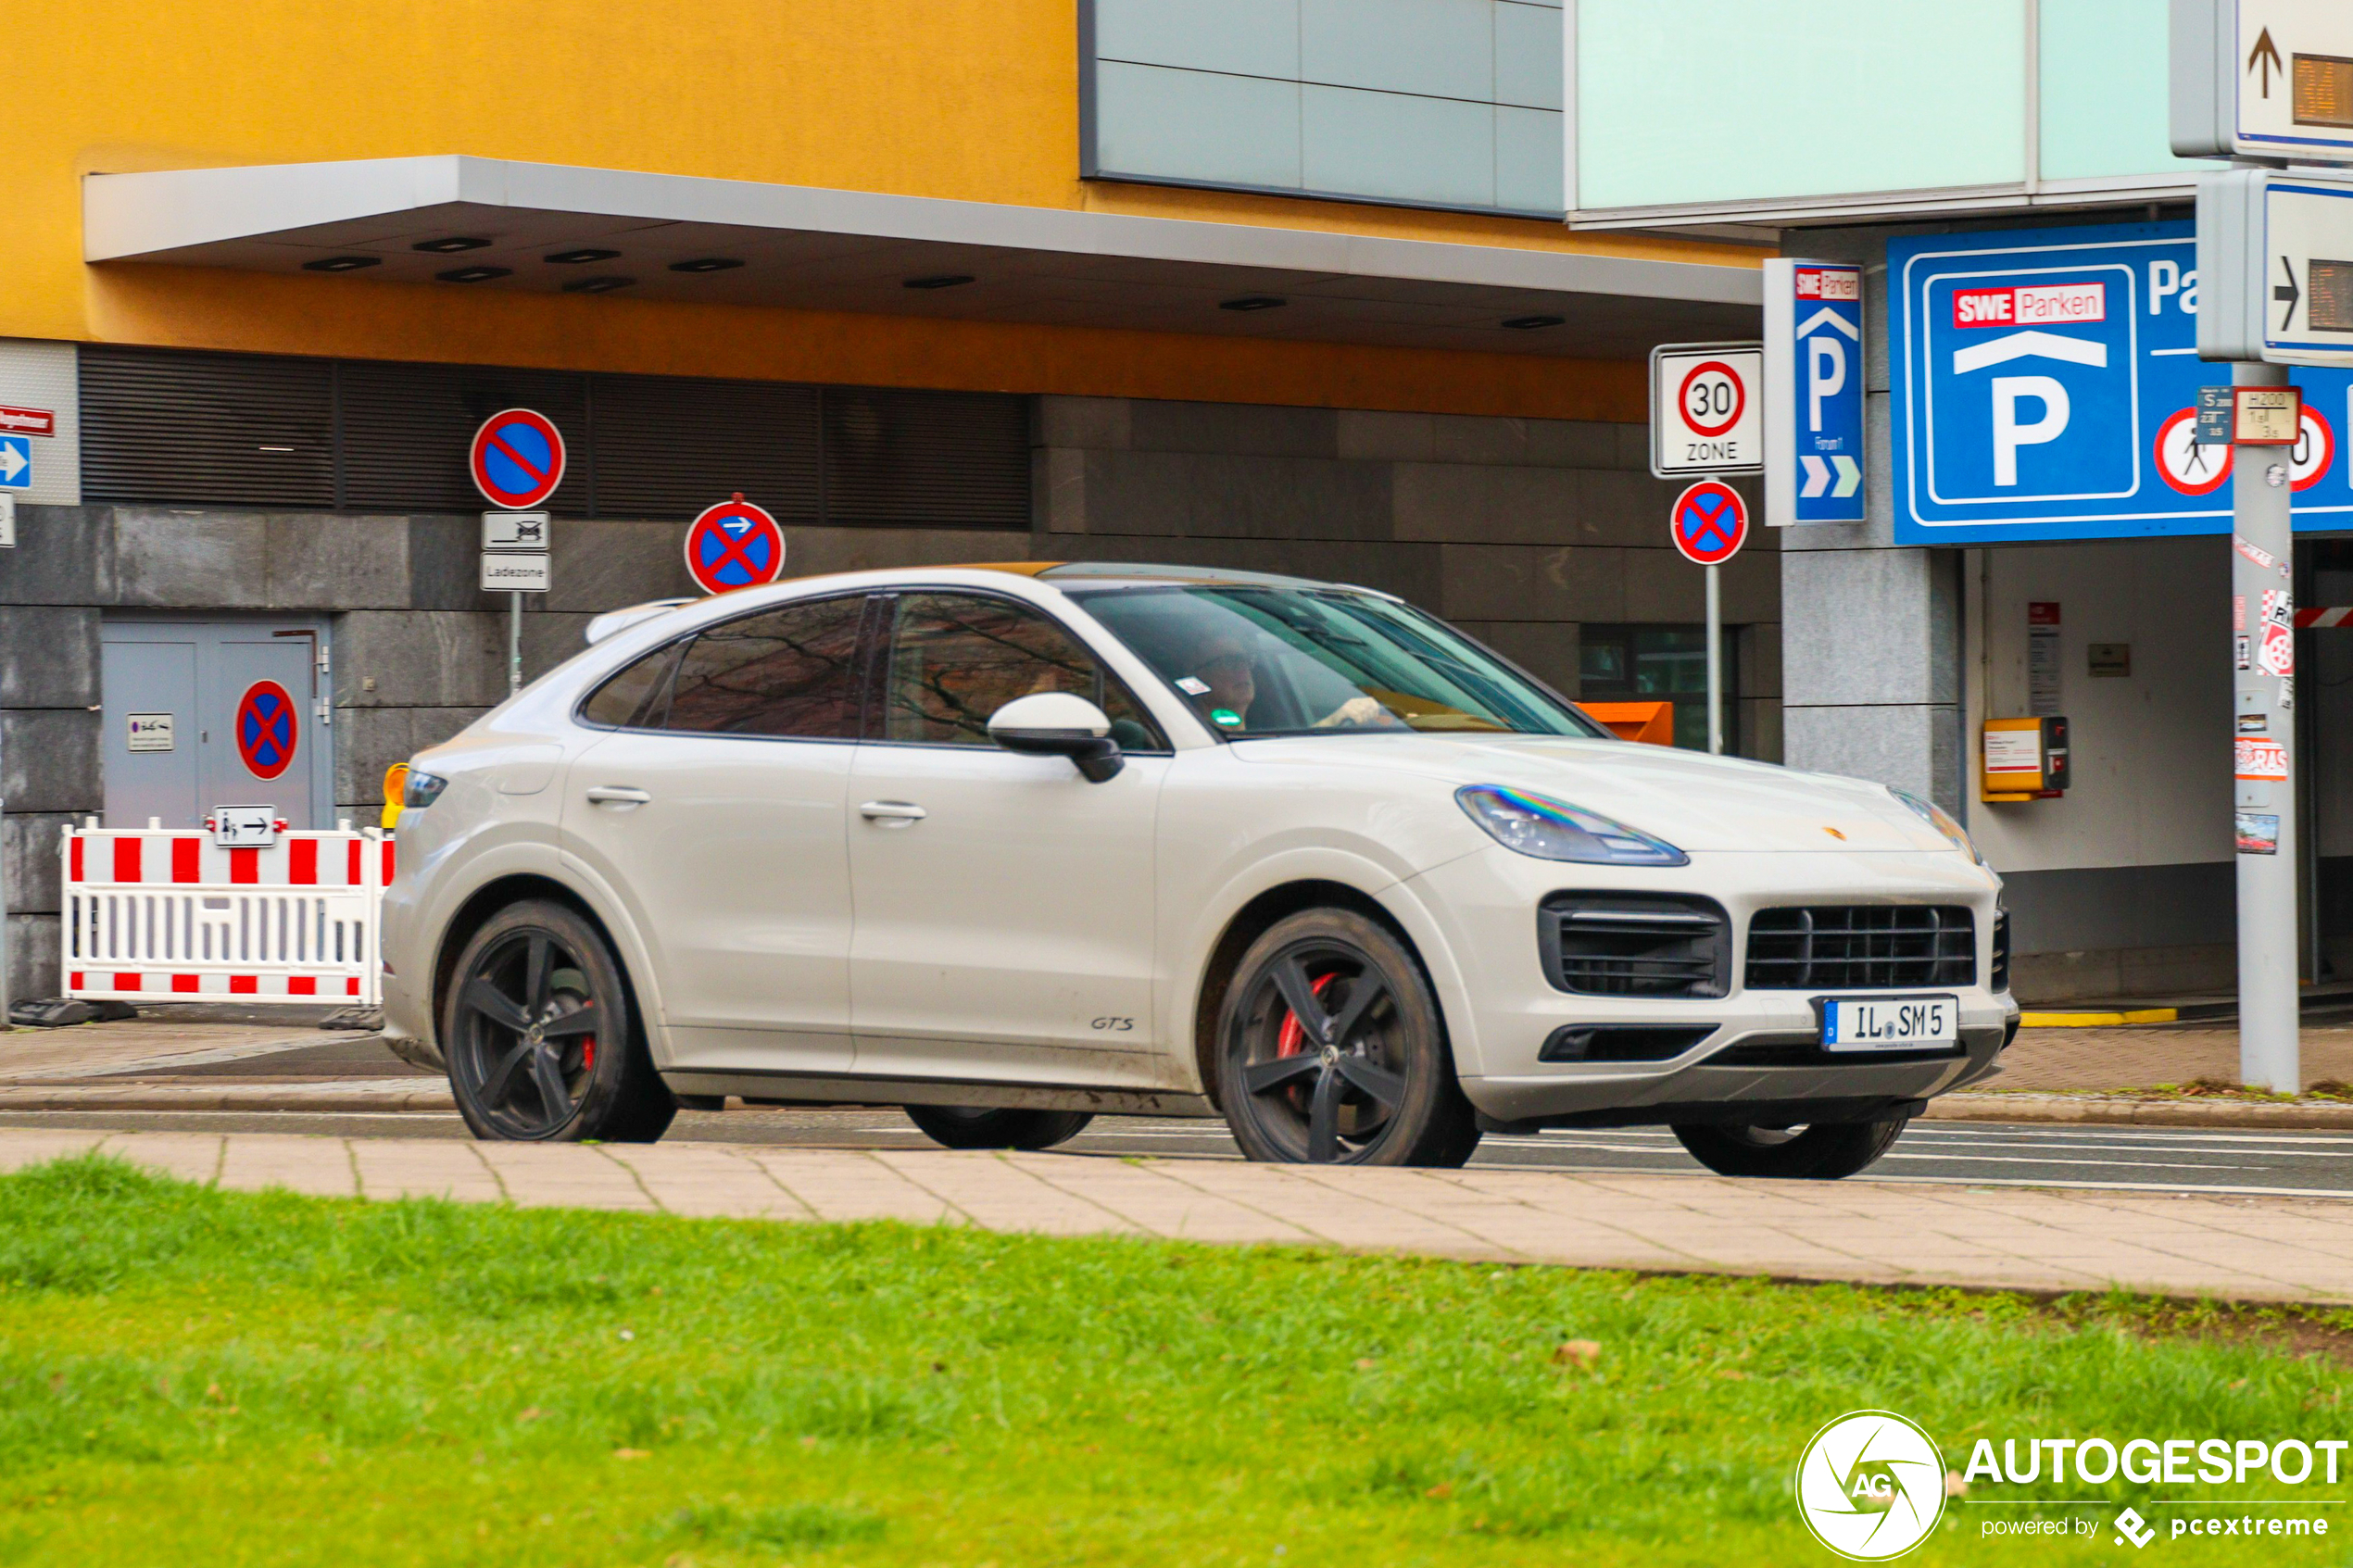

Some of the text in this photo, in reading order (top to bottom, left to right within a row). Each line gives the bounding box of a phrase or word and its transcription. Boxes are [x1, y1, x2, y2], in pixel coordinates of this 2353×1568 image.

[1797, 273, 1820, 295] SWE
[2149, 259, 2196, 316] Pa
[1957, 293, 2098, 322] SWE Parken
[1692, 381, 1730, 416] 30
[1808, 336, 1846, 433] P
[1991, 375, 2071, 487] P
[1686, 441, 1738, 461] ZONE
[486, 565, 546, 578] Ladezone
[1091, 1017, 1135, 1031] GTS
[1855, 1006, 1882, 1038] IL
